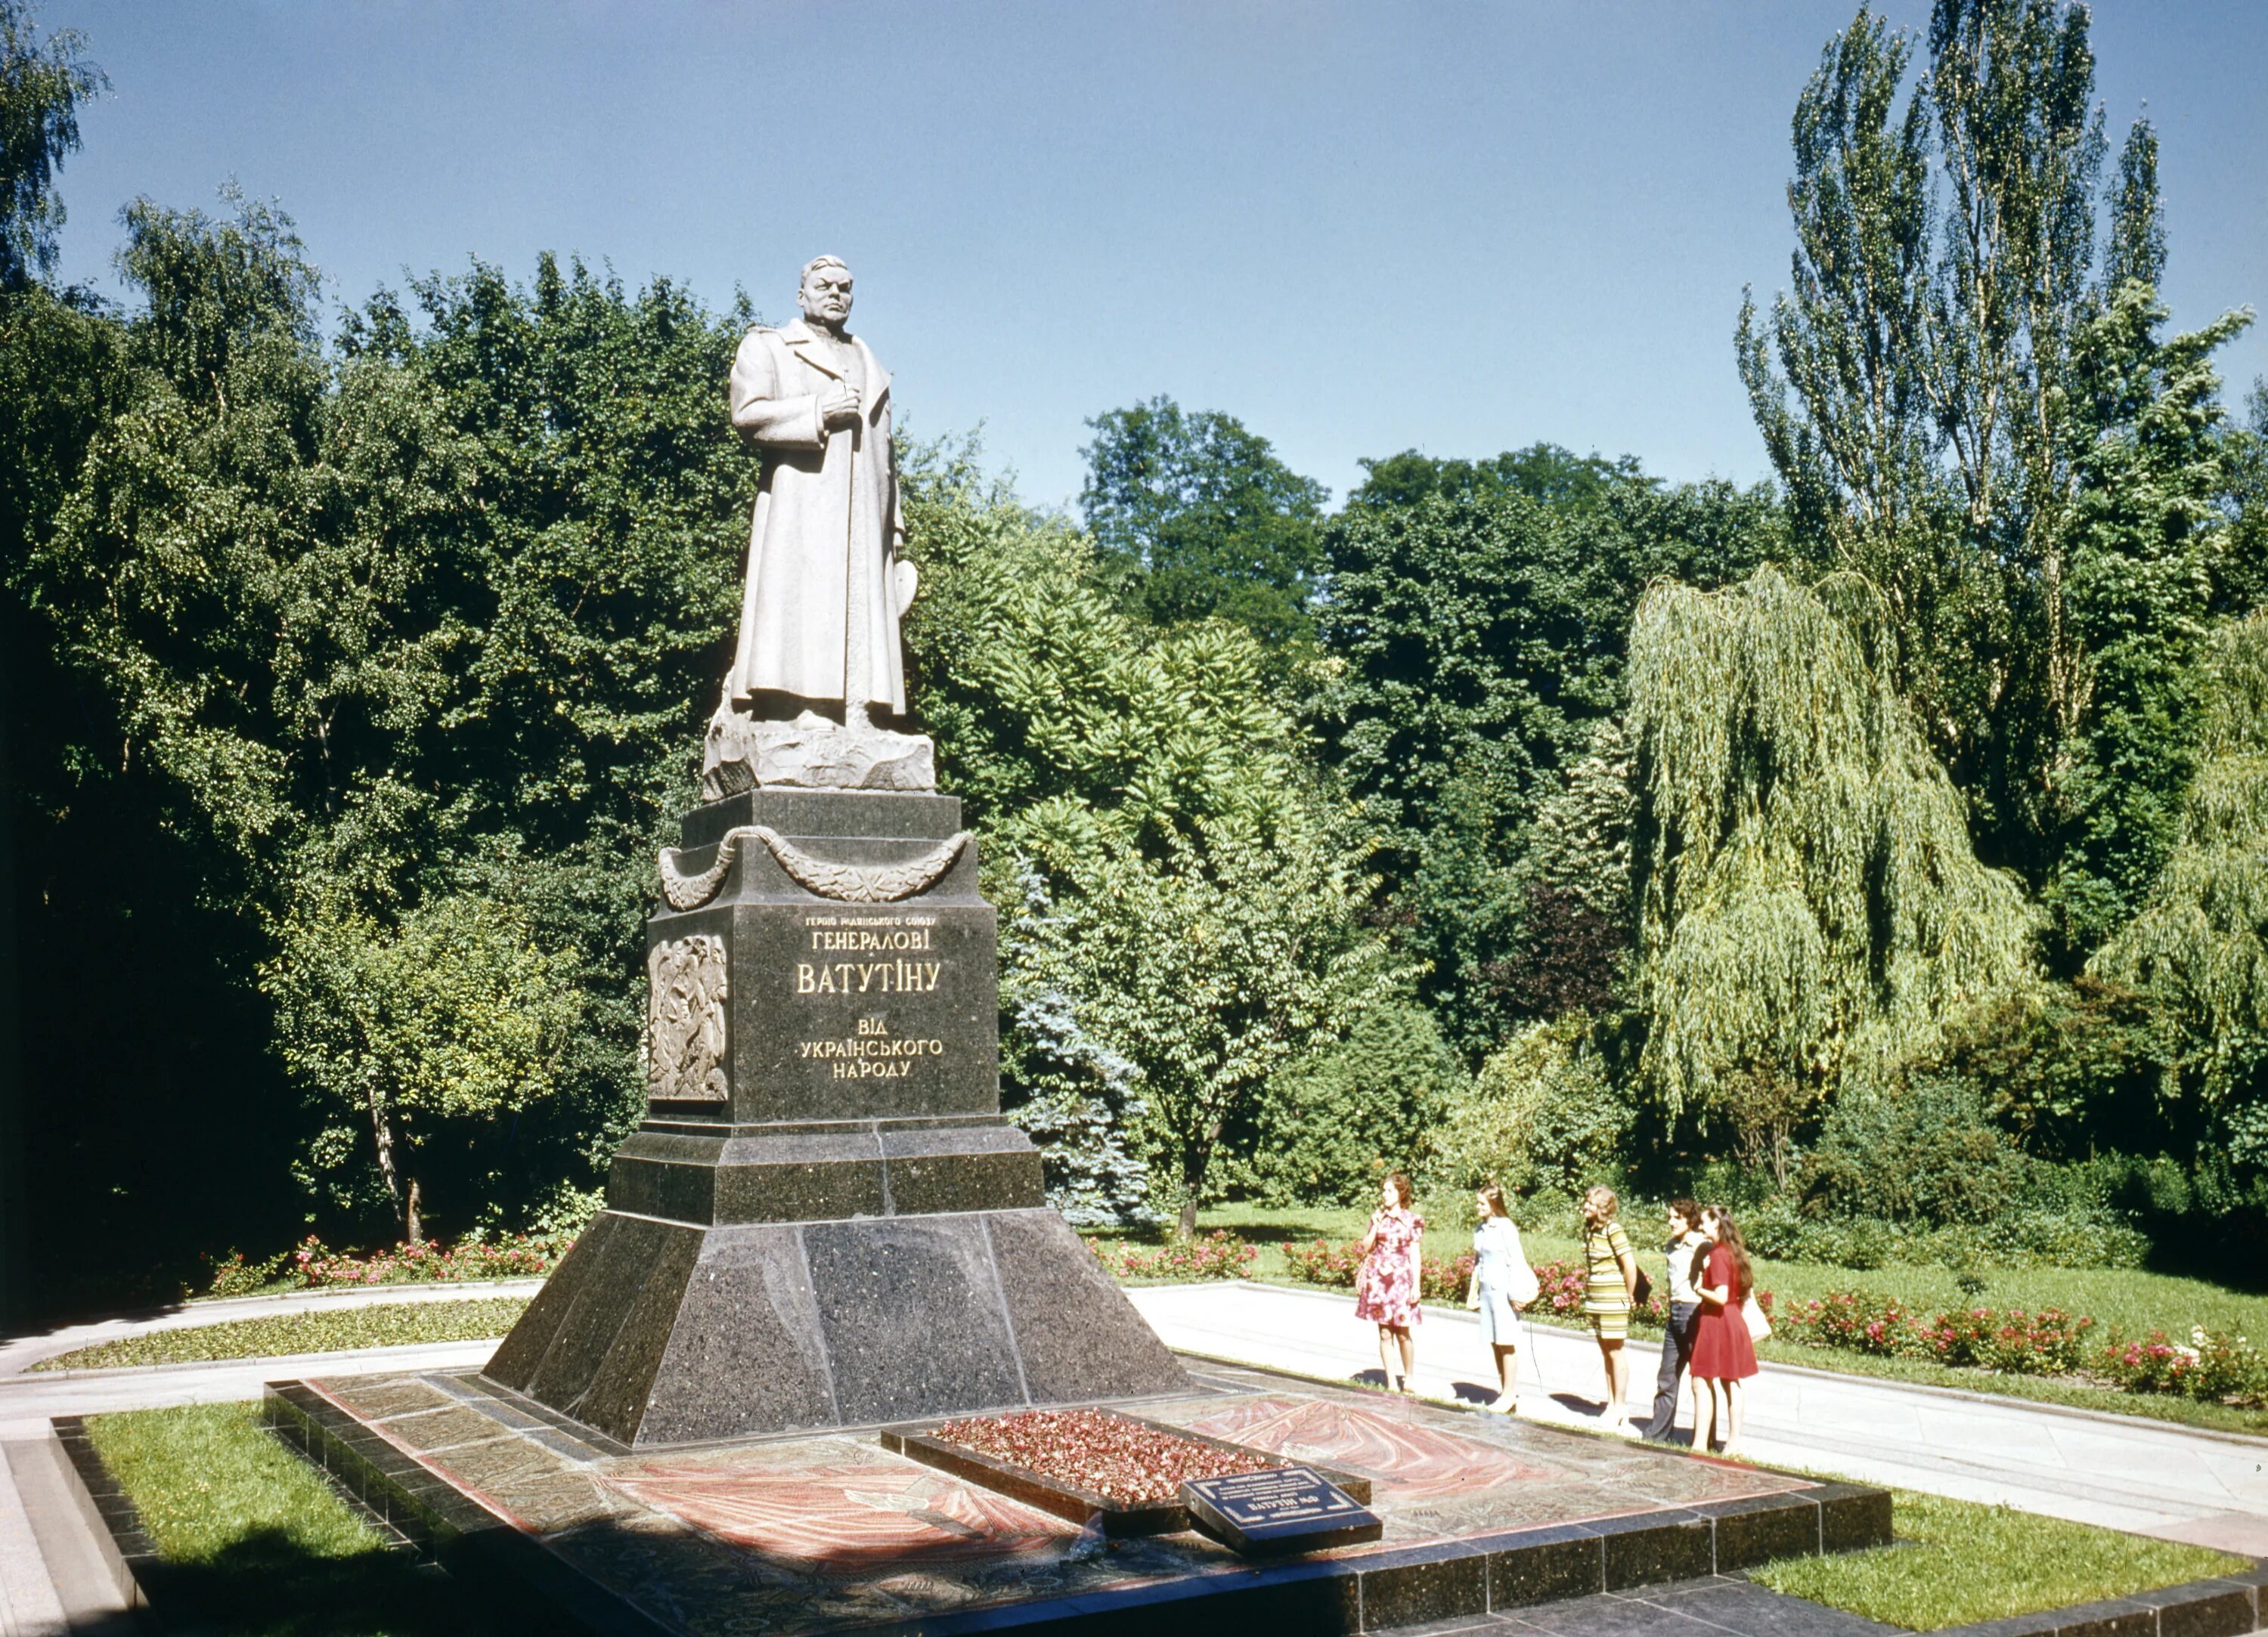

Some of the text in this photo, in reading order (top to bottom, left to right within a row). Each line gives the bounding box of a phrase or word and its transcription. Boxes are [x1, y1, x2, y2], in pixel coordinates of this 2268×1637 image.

[806, 916, 937, 926] ГЕРОЮ РАДЯНСЬКОГО СОЮЗУ
[812, 928, 930, 950] ГЕНЕРАЛОВІ
[798, 958, 940, 993] ВАТУТІНУ
[858, 1017, 888, 1035] ВІД
[801, 1038, 943, 1058] УКРАЇНСЬКОГО
[833, 1060, 910, 1078] НАРОДУ
[1247, 1498, 1298, 1511] ВАТУТІН
